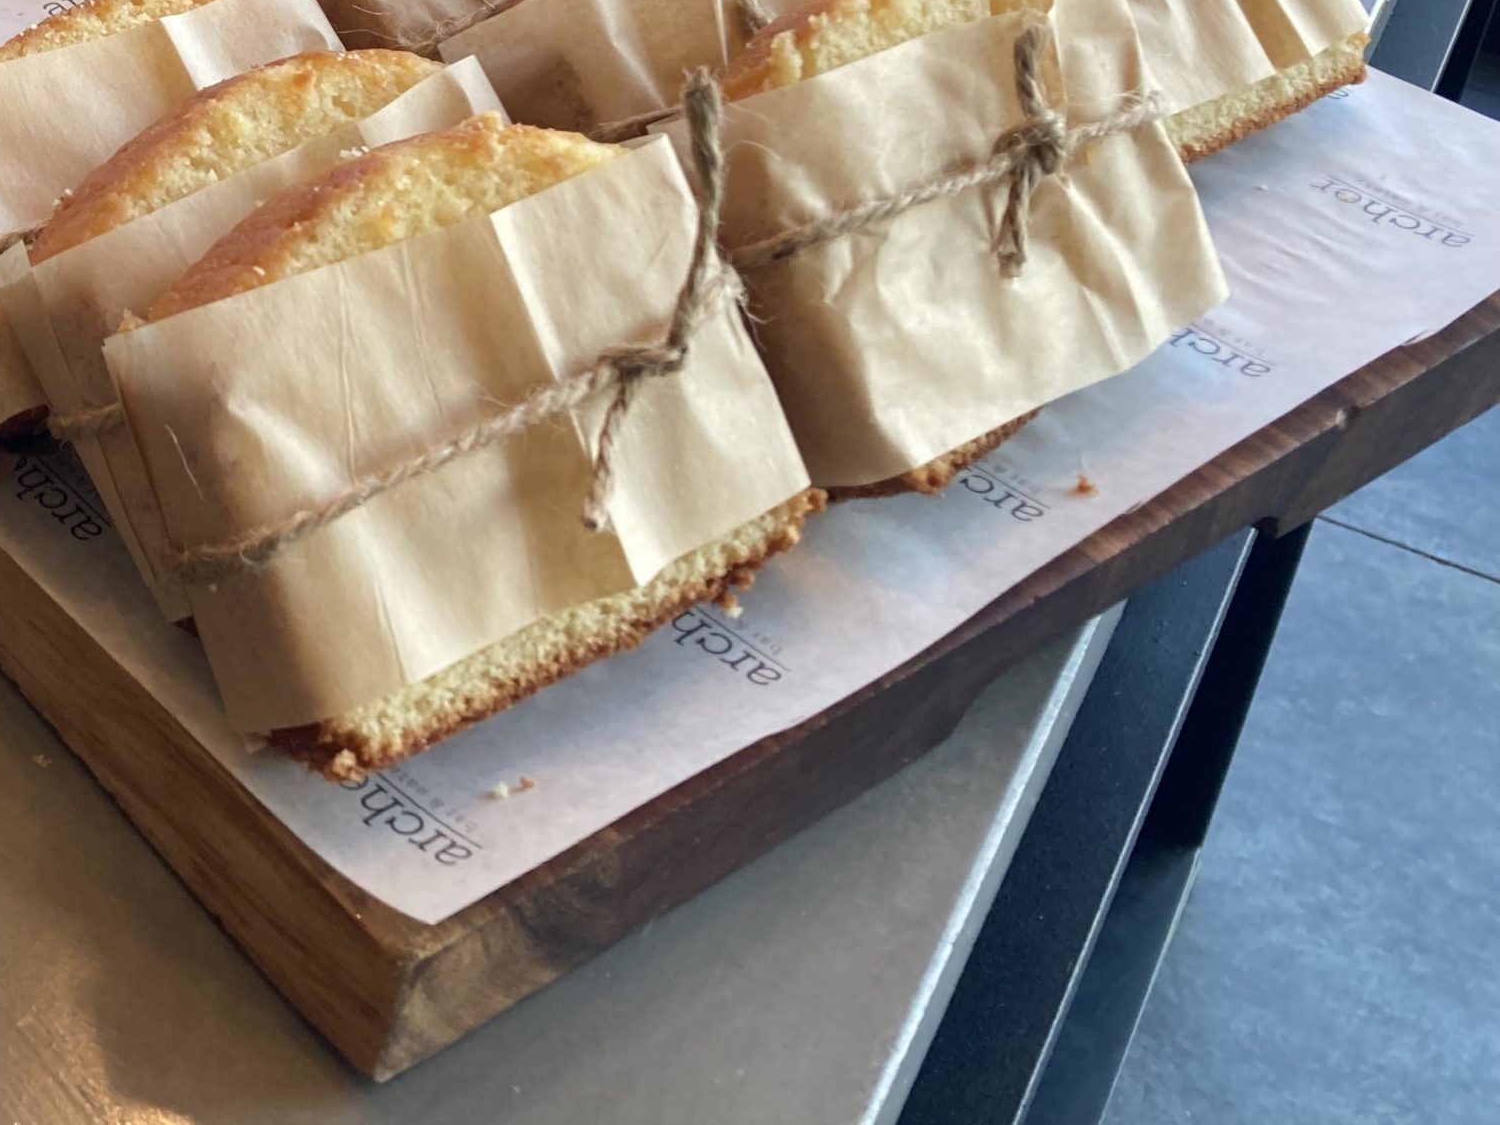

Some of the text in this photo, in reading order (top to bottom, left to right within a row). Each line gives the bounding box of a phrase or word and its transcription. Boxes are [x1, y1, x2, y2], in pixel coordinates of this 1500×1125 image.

[1310, 179, 1470, 248] archer
[960, 469, 1044, 522] arc
[672, 611, 781, 686] arch
